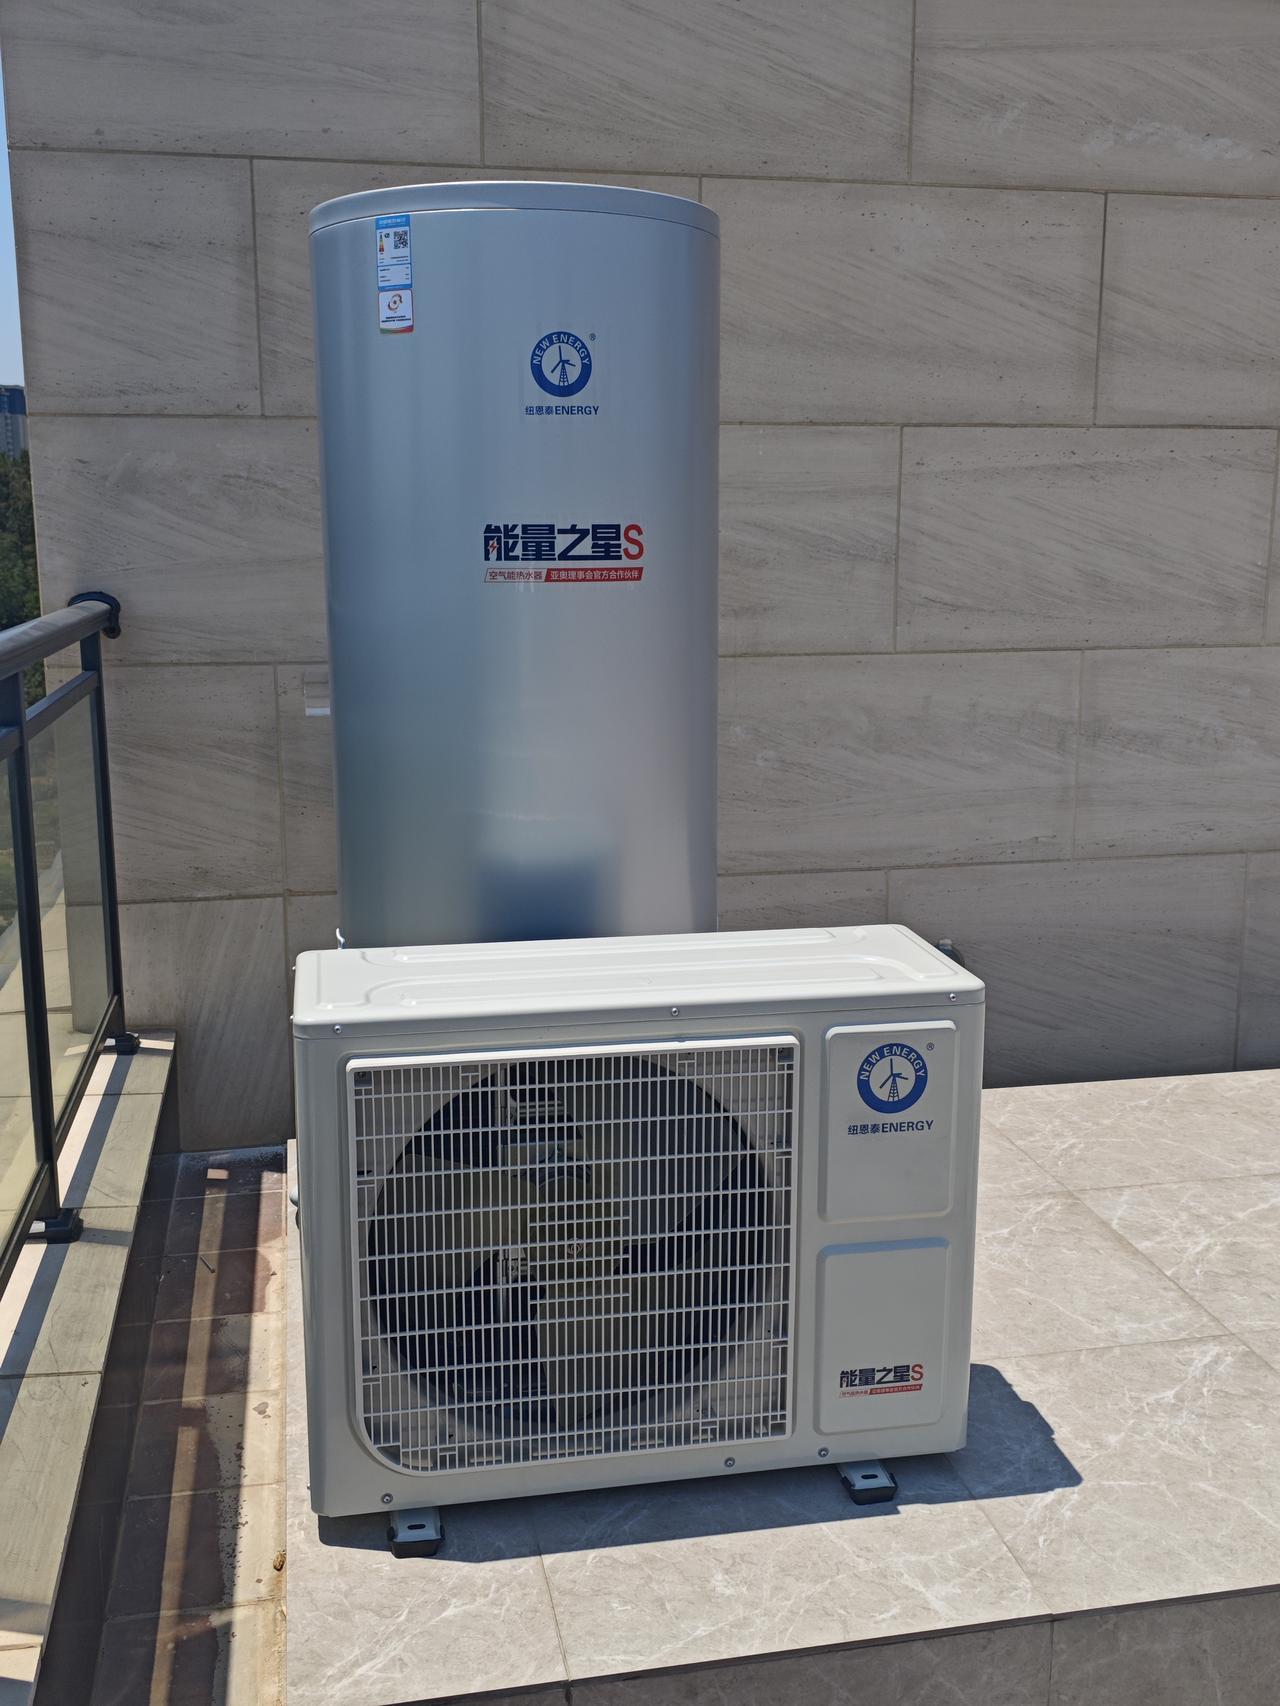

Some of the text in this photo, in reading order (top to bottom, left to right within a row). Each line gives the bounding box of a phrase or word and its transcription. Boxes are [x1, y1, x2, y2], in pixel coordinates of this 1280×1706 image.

[532, 333, 590, 365] NEW ENERGY
[483, 523, 644, 561] 能量之星S
[488, 570, 543, 580] 空气能热水器
[859, 1045, 926, 1080] NEW ENERGY
[839, 1363, 924, 1388] 能量之星S
